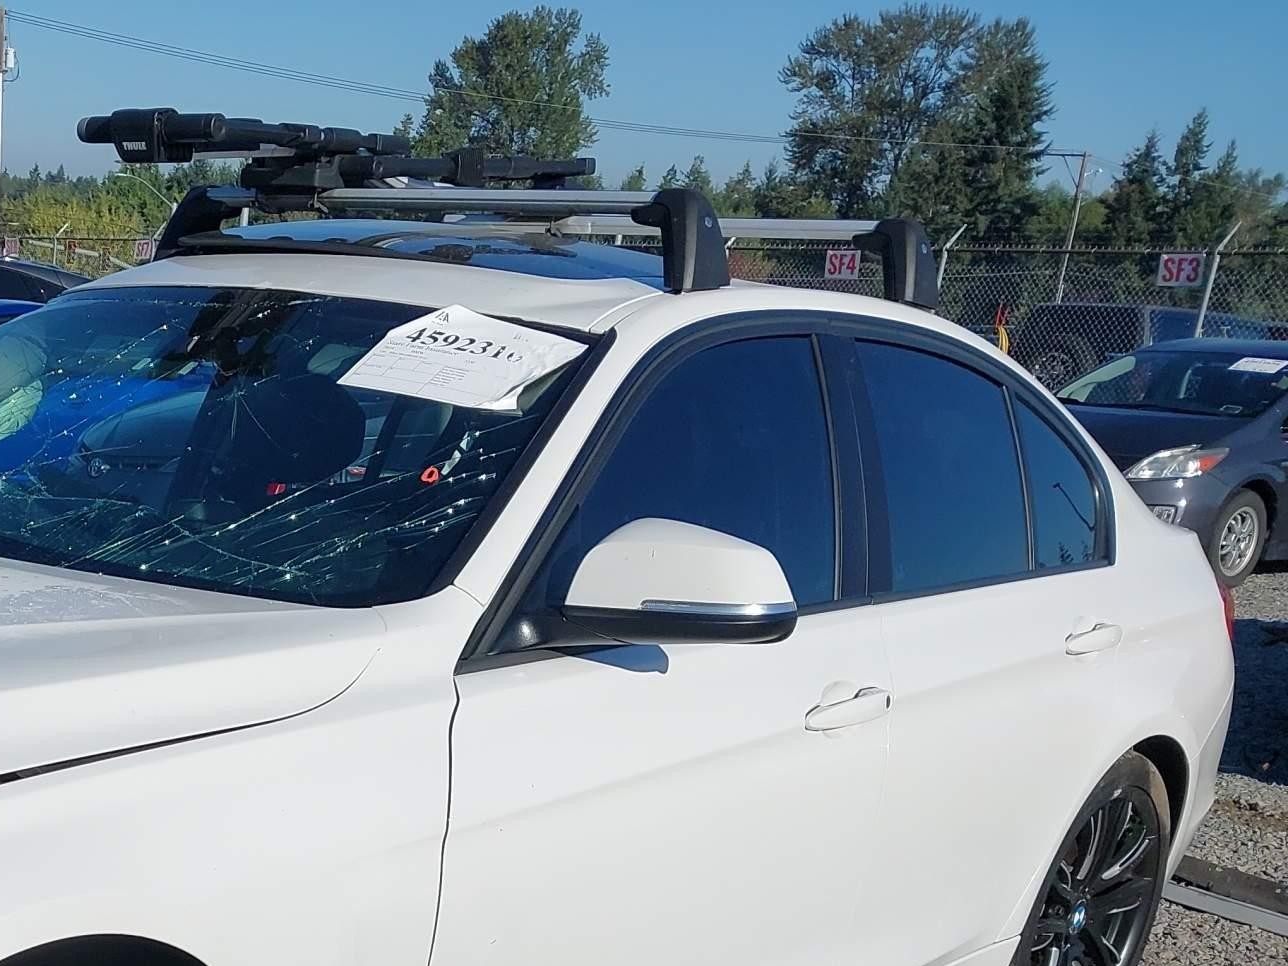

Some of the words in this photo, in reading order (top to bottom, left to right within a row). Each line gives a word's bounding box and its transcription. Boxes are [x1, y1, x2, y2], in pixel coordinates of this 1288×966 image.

[122, 141, 147, 151] THULE
[827, 253, 857, 276] SF4
[1161, 257, 1201, 283] SF3
